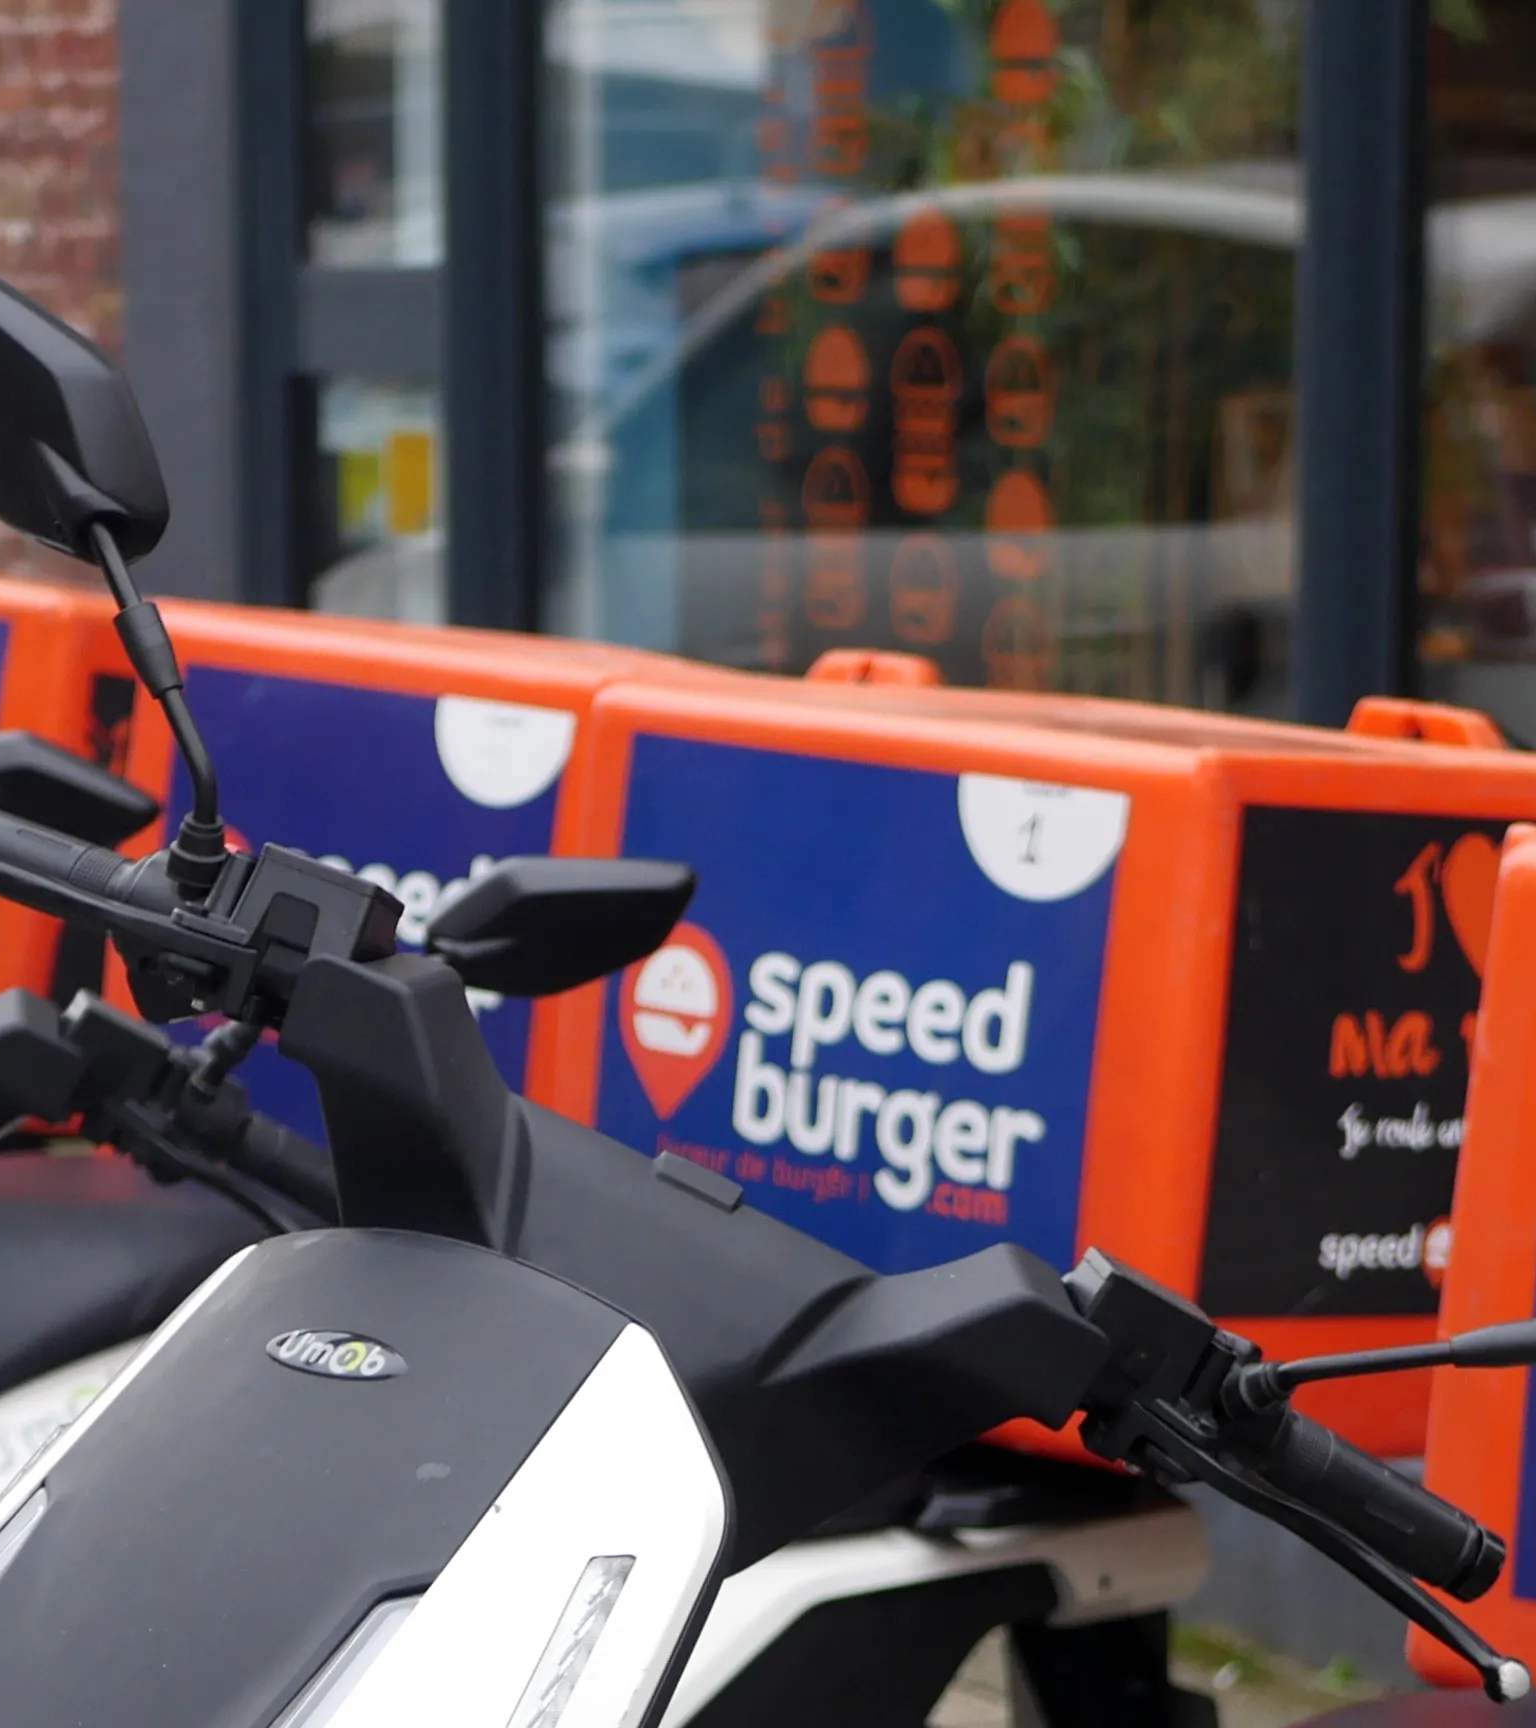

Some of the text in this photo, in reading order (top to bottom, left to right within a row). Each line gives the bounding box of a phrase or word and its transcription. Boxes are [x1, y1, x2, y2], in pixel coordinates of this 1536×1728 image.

[744, 951, 1035, 1075] speed
[732, 1030, 1047, 1213] burger
[1318, 1222, 1426, 1281] speed
